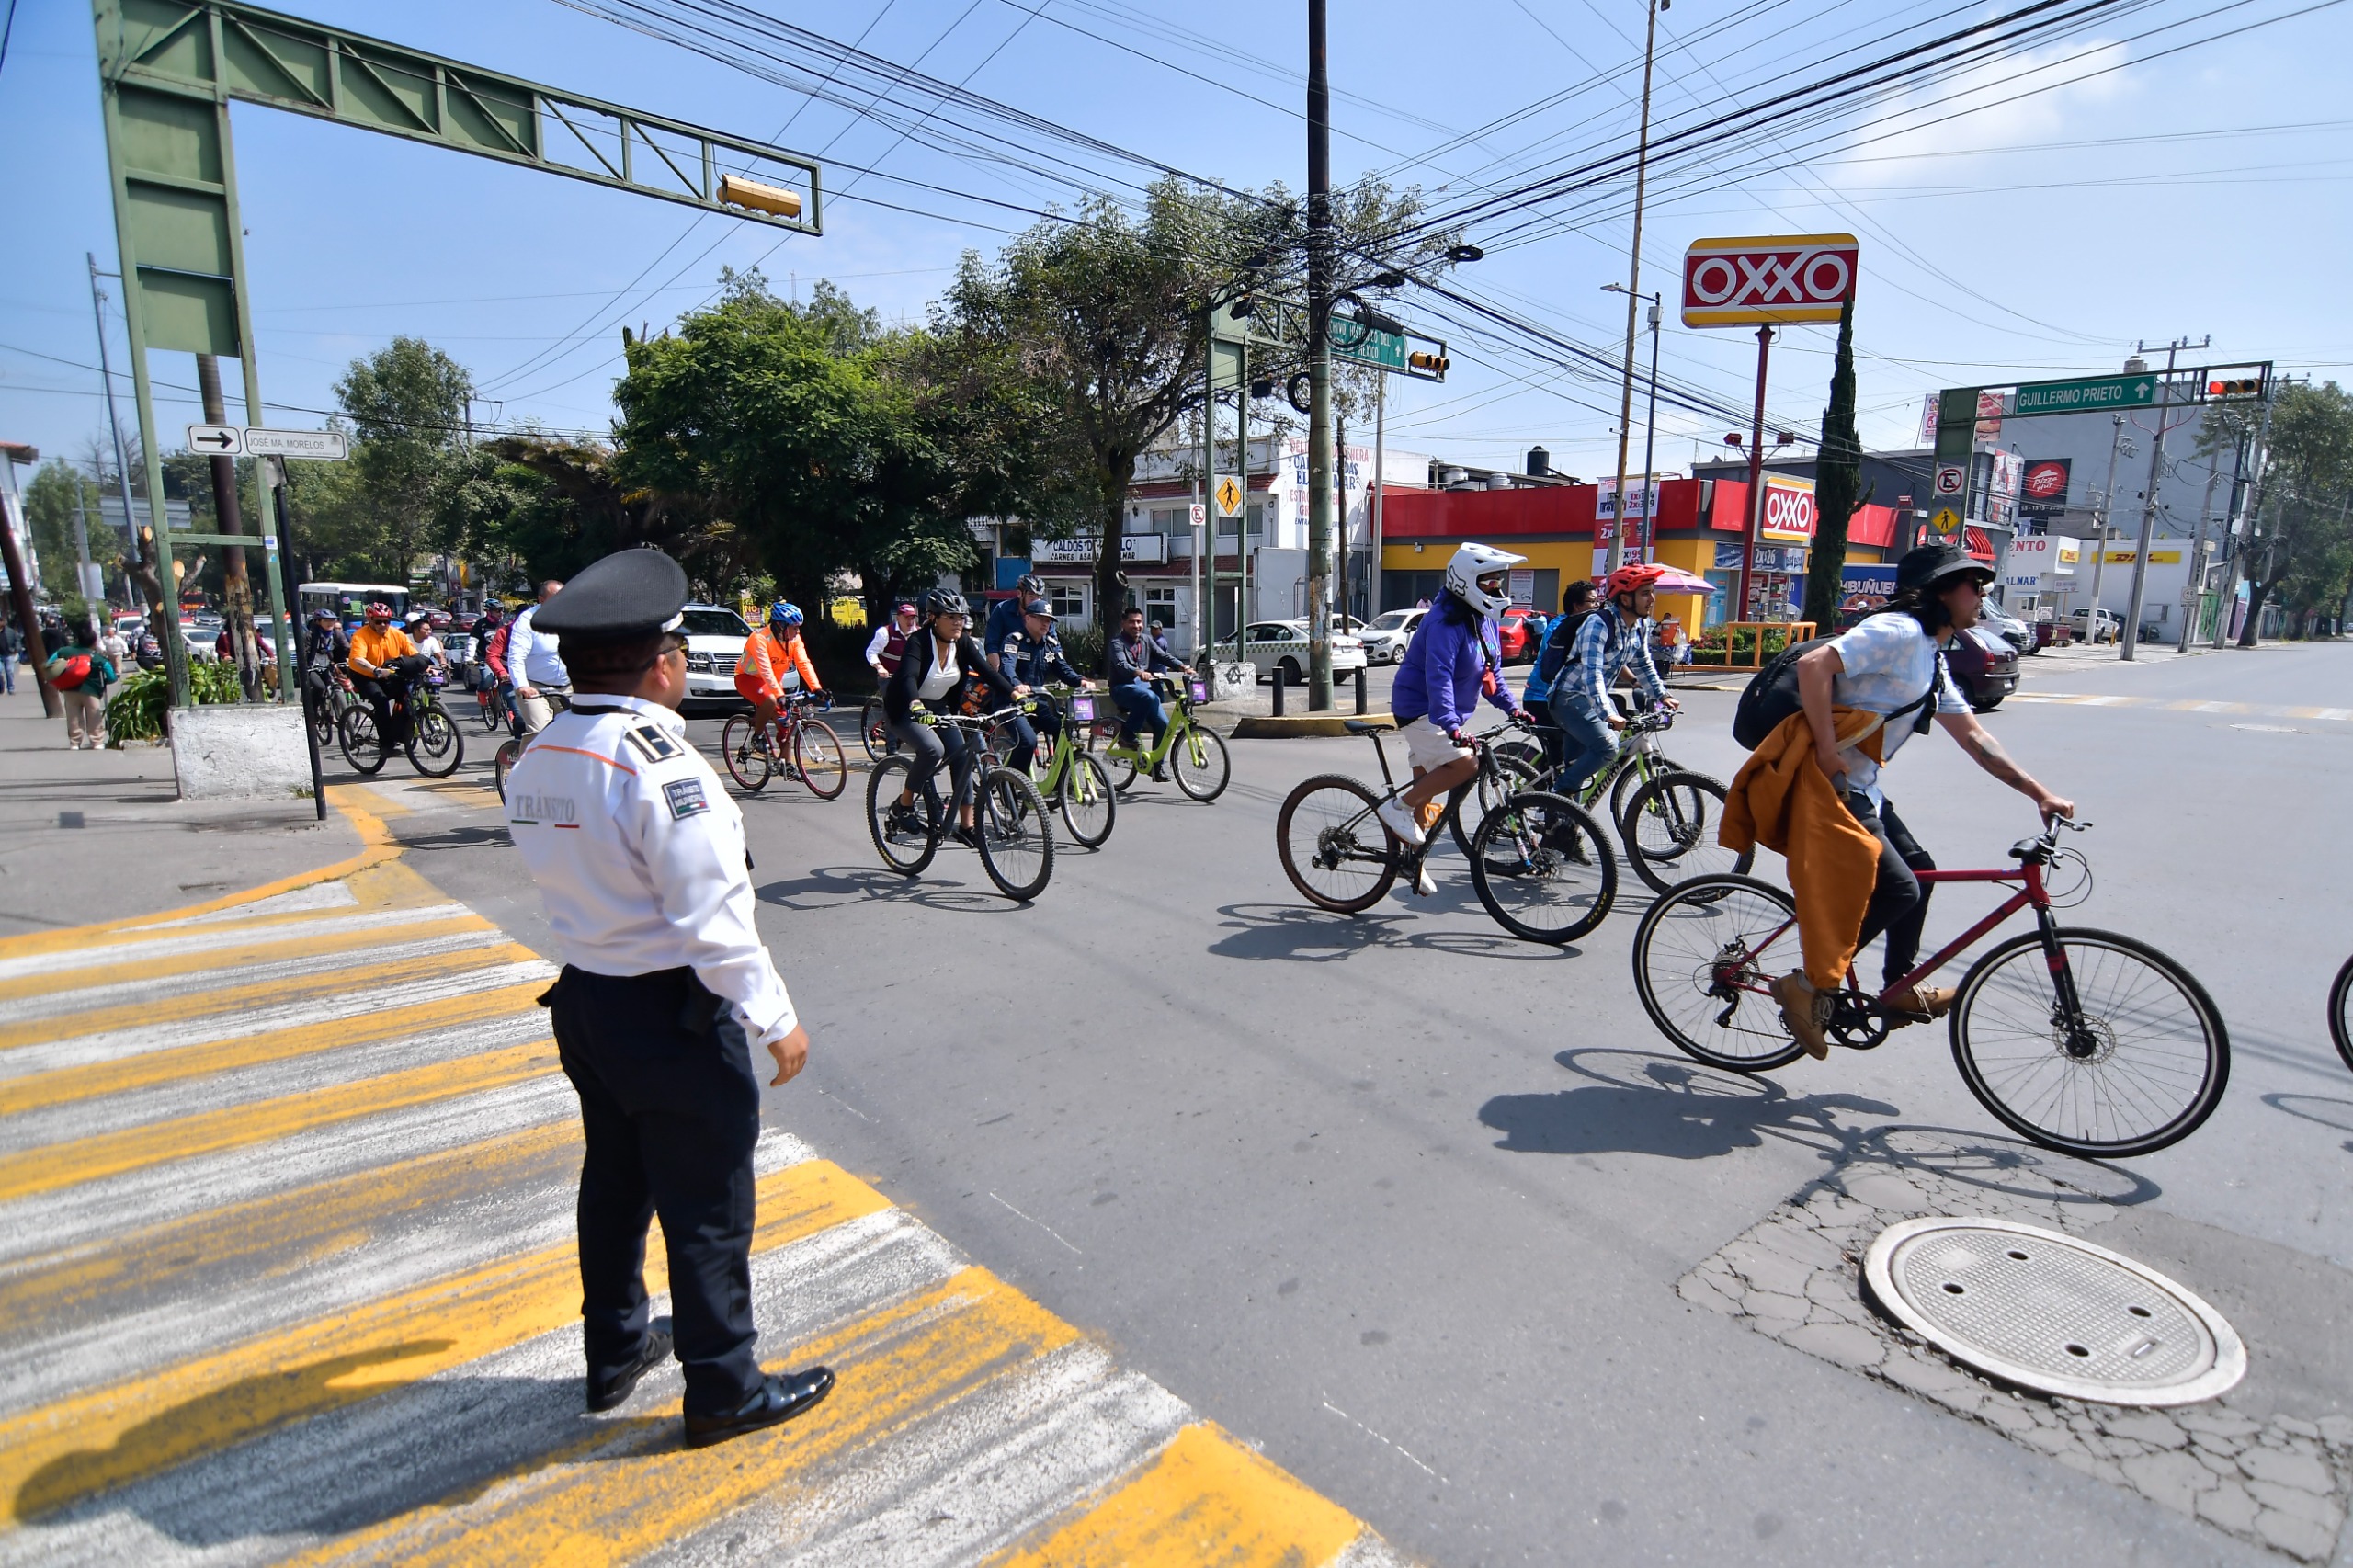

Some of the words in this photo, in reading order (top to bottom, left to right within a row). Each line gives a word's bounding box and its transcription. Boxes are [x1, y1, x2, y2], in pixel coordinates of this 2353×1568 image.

[1692, 253, 1849, 305] OXXO
[2018, 388, 2081, 407] GUILLERMO
[2082, 384, 2123, 403] PRIETO
[249, 436, 269, 448] JOSÉ
[270, 438, 285, 449] MA.
[287, 438, 325, 450] MORELOS
[2037, 482, 2055, 492] Hut
[1767, 492, 1810, 529] OXXO
